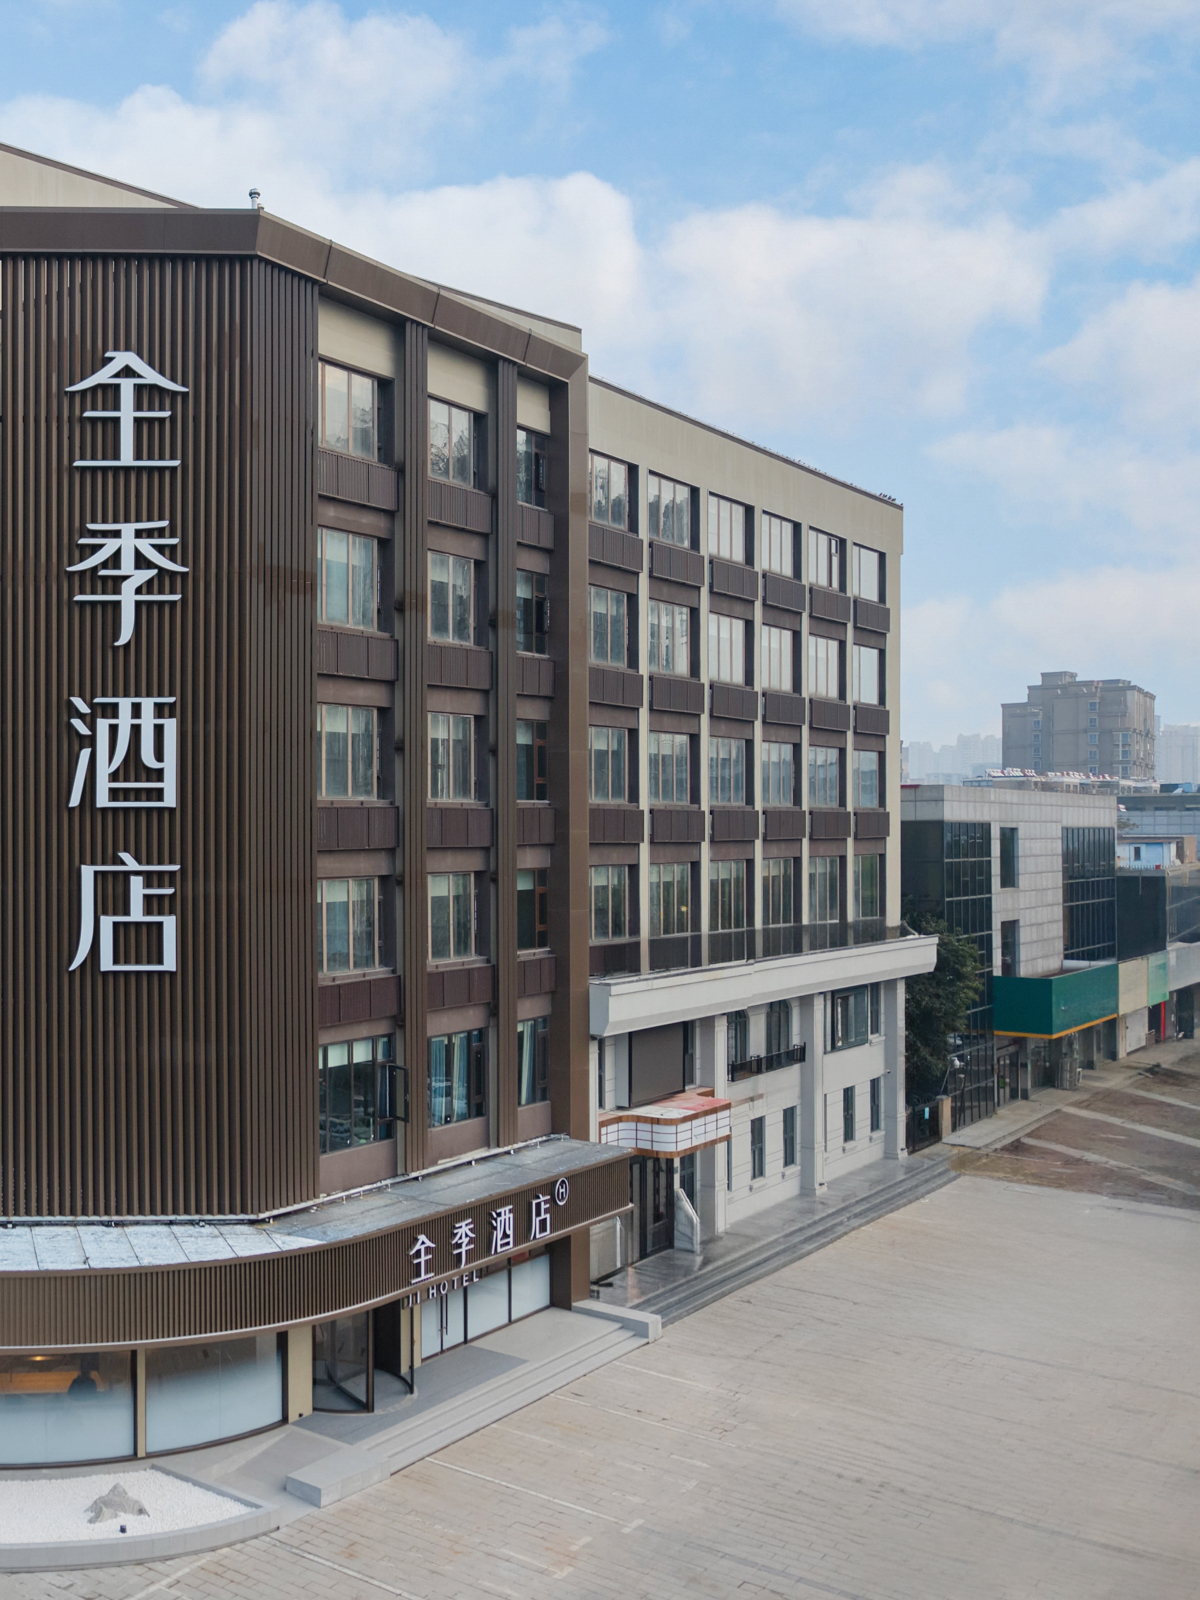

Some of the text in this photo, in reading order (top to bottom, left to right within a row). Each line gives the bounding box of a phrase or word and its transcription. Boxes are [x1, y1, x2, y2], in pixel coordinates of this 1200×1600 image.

[65, 350, 190, 973] 全季酒店
[409, 1193, 551, 1285] 全季酒店
[429, 1269, 480, 1299] HOTEL
